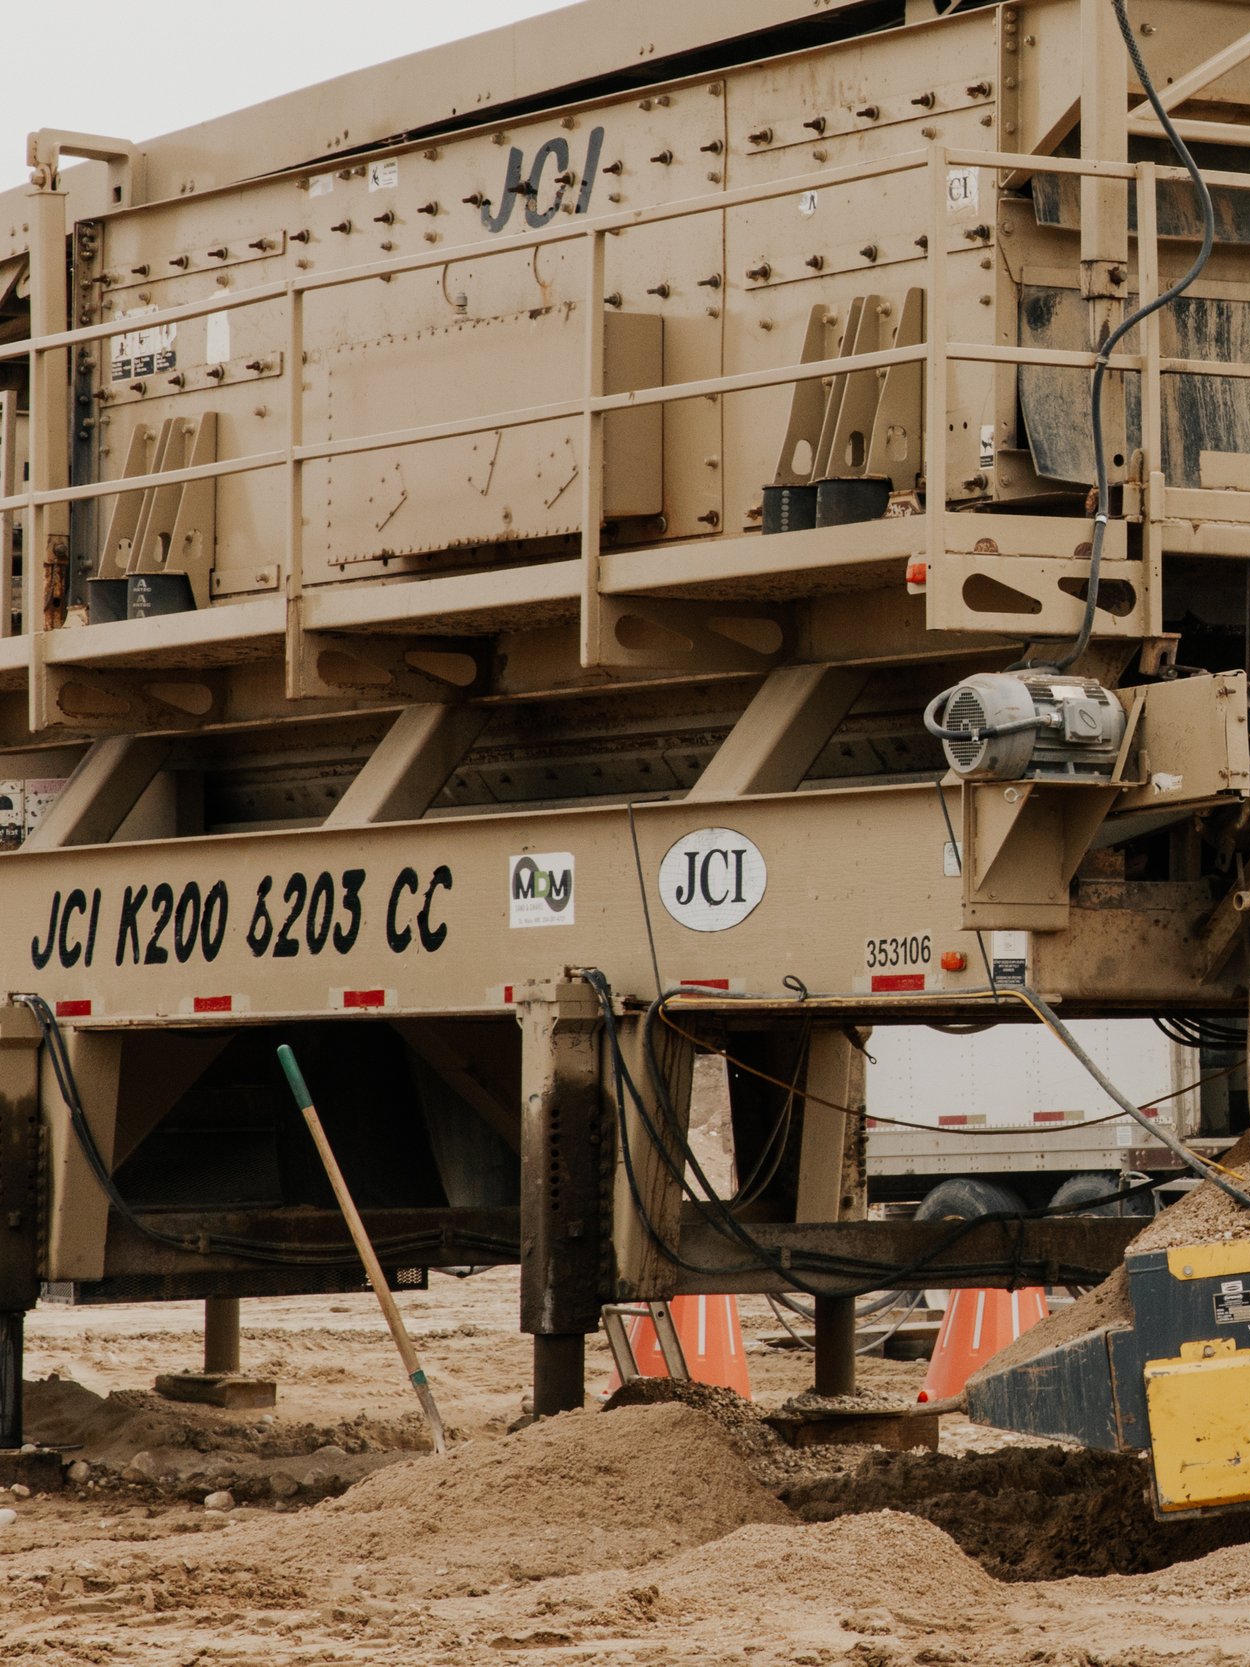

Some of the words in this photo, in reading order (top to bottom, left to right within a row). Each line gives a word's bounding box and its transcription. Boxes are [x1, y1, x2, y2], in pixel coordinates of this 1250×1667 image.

[481, 126, 604, 233] JCI
[31, 887, 101, 970] JCI
[115, 880, 229, 967] K200
[247, 869, 366, 957] 6203
[386, 865, 452, 953] CC
[675, 848, 747, 907] JCI
[867, 935, 931, 968] 353106
